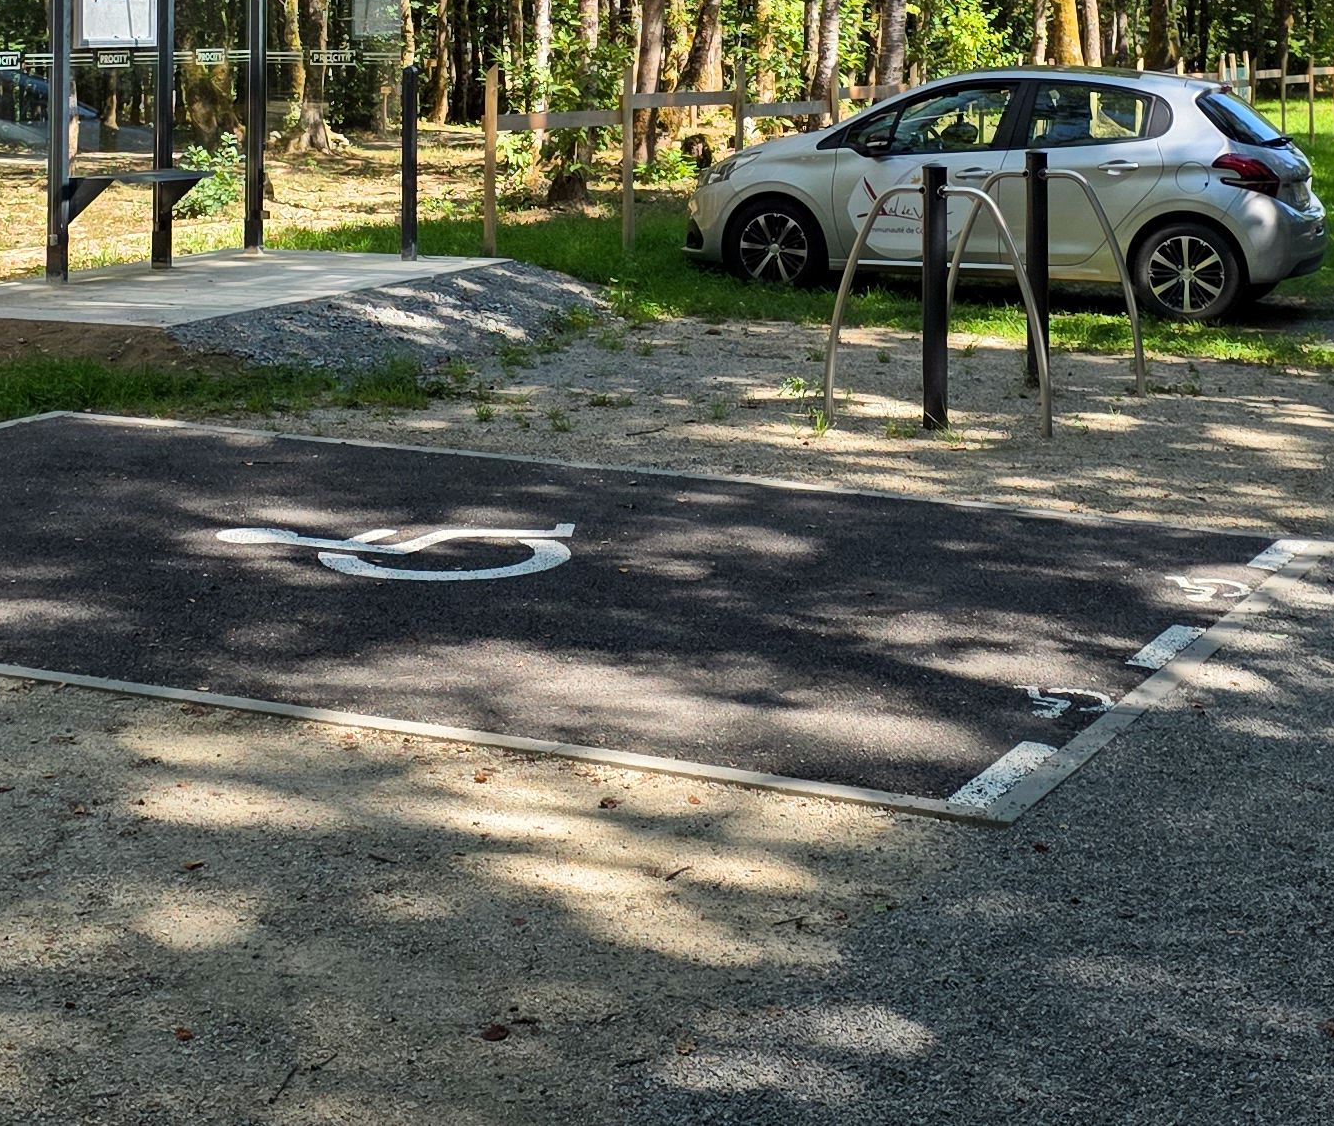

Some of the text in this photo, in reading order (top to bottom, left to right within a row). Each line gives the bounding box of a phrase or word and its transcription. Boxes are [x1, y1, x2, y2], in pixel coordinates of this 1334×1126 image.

[99, 54, 128, 64] PROCITY
[313, 53, 351, 63] PROCITY
[906, 226, 915, 235] de
